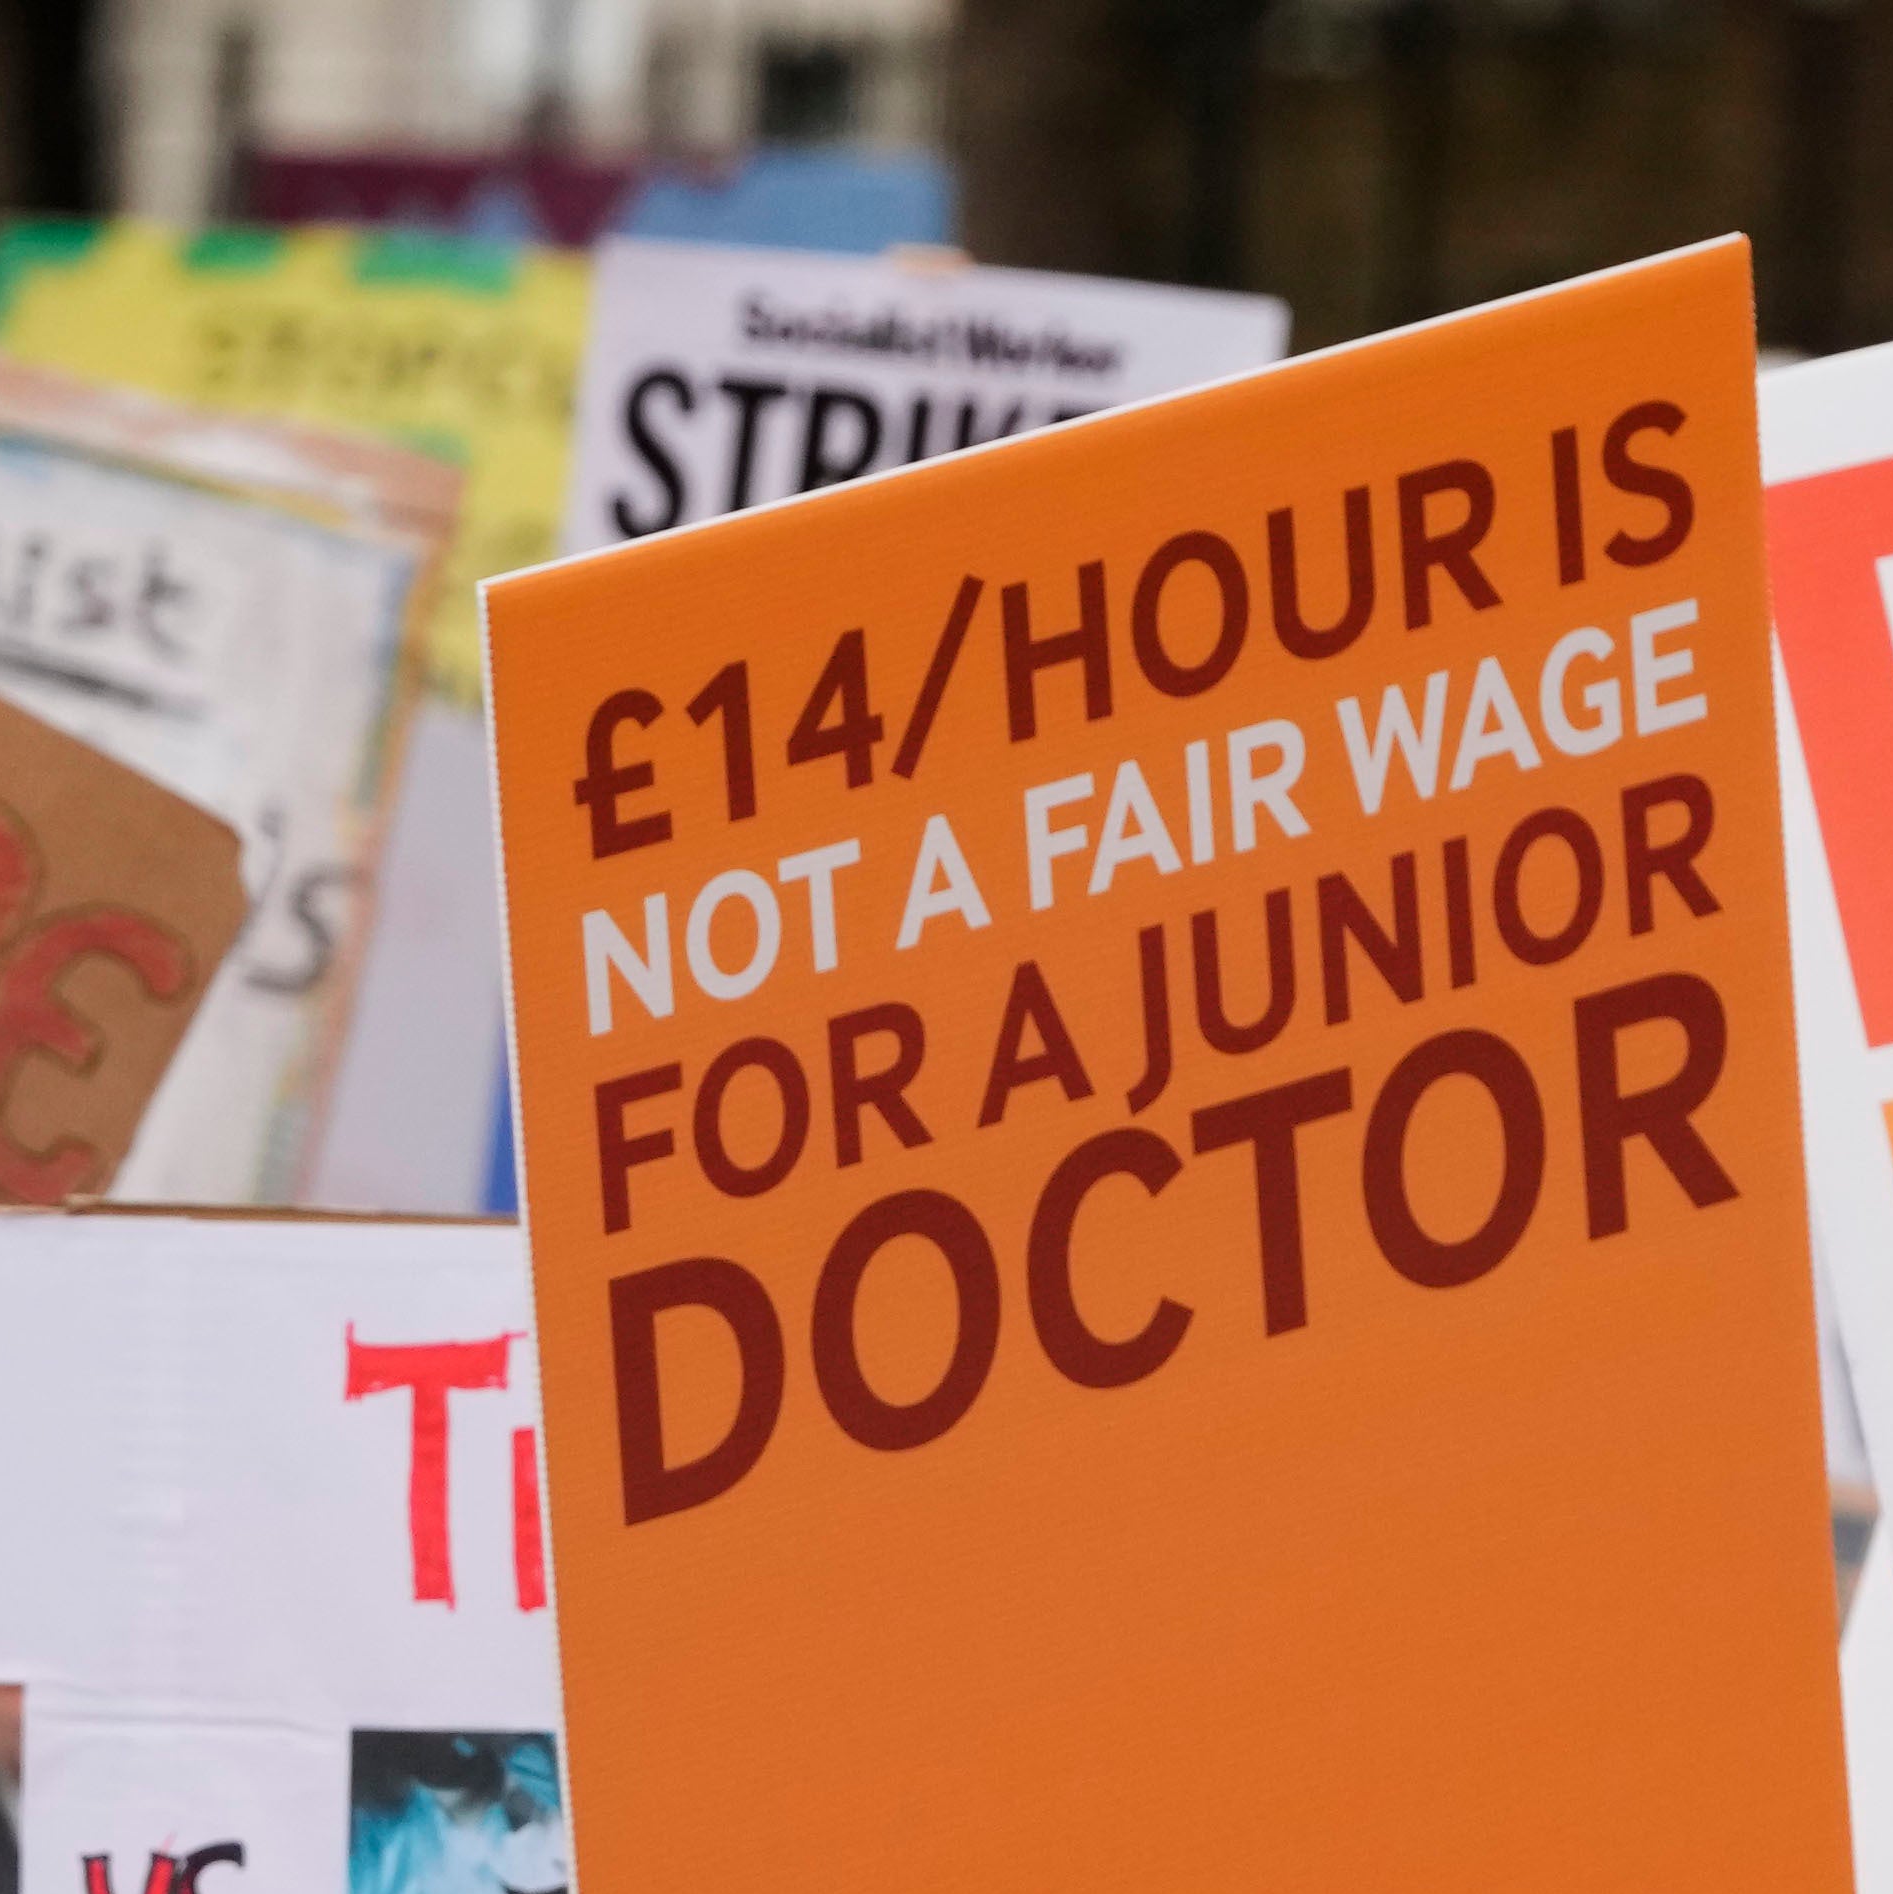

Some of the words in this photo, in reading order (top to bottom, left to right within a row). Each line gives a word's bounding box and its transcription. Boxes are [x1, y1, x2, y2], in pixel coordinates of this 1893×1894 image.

[574, 458, 1504, 860] £14/HOUR
[1552, 400, 1696, 587] IS
[582, 840, 862, 1037] NOT
[896, 813, 993, 950] A
[1024, 716, 1310, 911] FAIR
[1338, 599, 1708, 815] WAGE
[594, 1001, 935, 1235] FOR
[977, 960, 1096, 1129] A
[1125, 772, 1724, 1115] JUNIOR
[607, 971, 1741, 1527] DOCTOR
